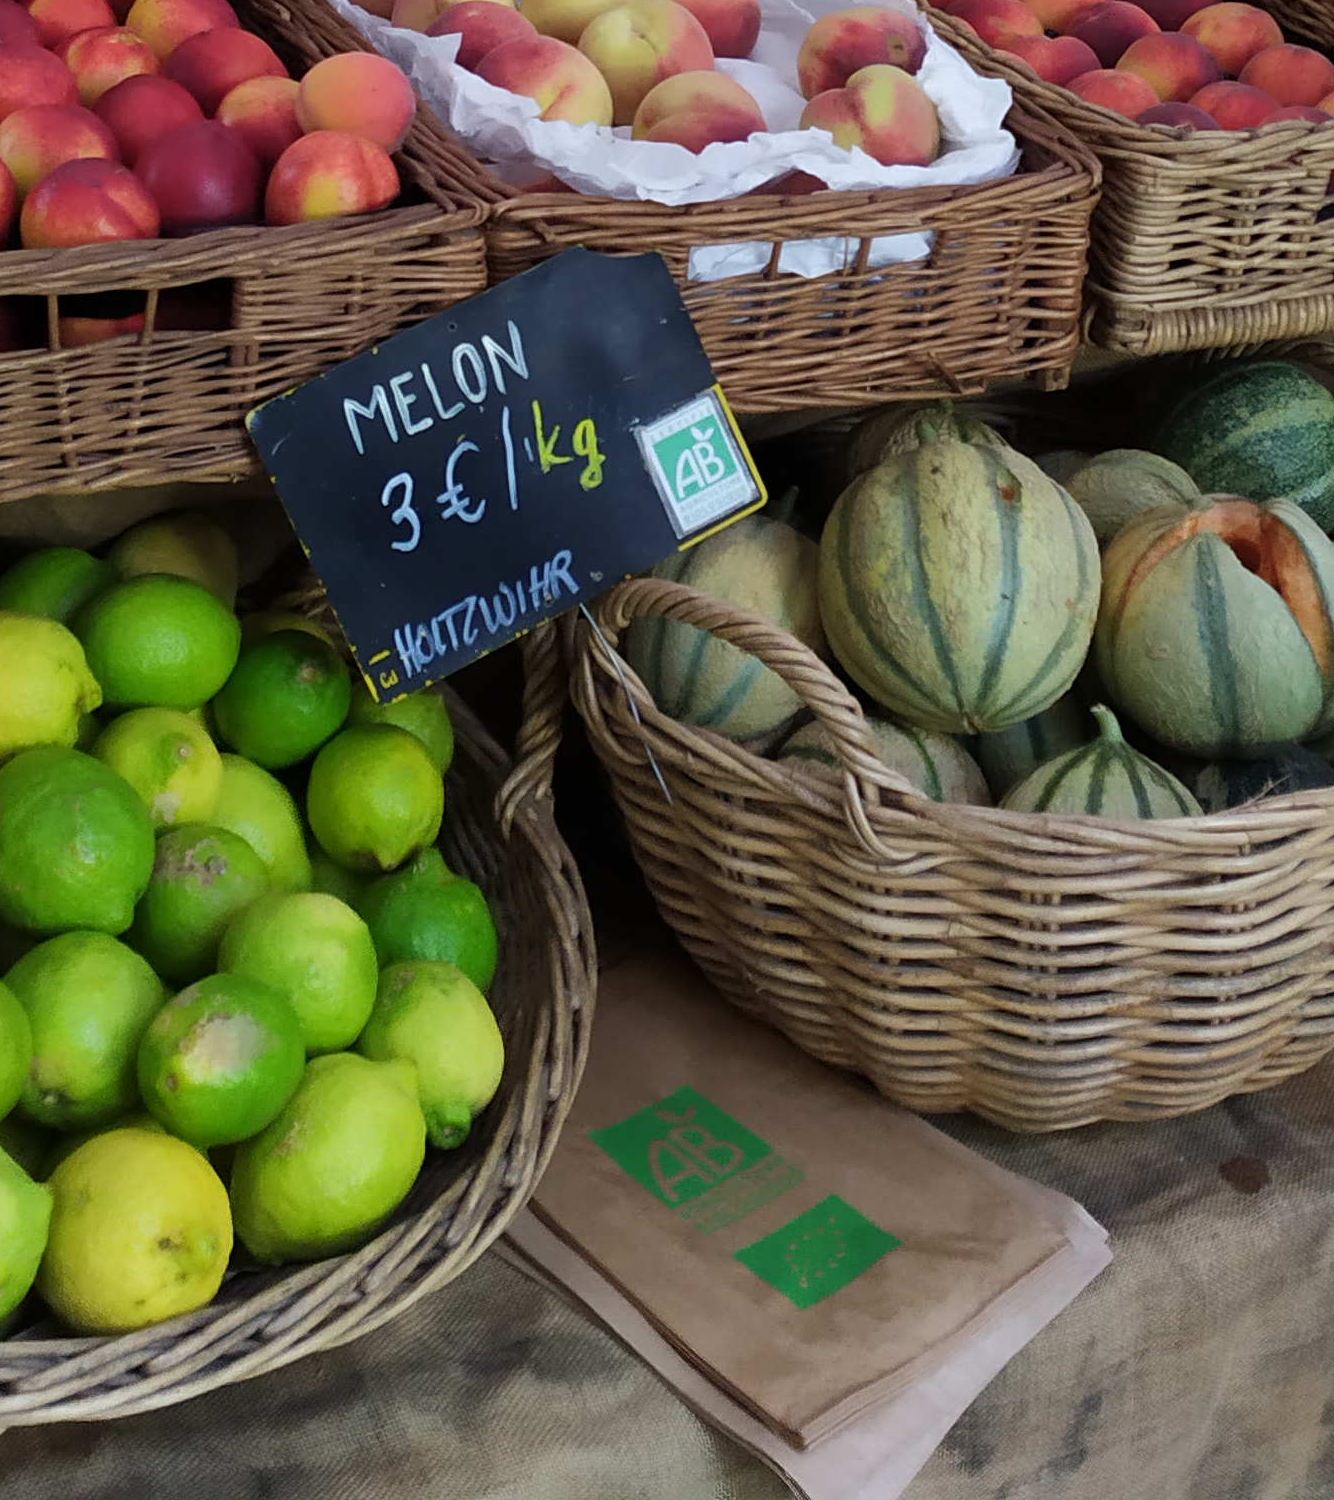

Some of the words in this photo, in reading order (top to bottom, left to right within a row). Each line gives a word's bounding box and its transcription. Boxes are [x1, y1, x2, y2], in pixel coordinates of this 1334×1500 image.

[343, 320, 529, 455] MELON
[676, 441, 725, 499] AB
[647, 1123, 744, 1202] AB
